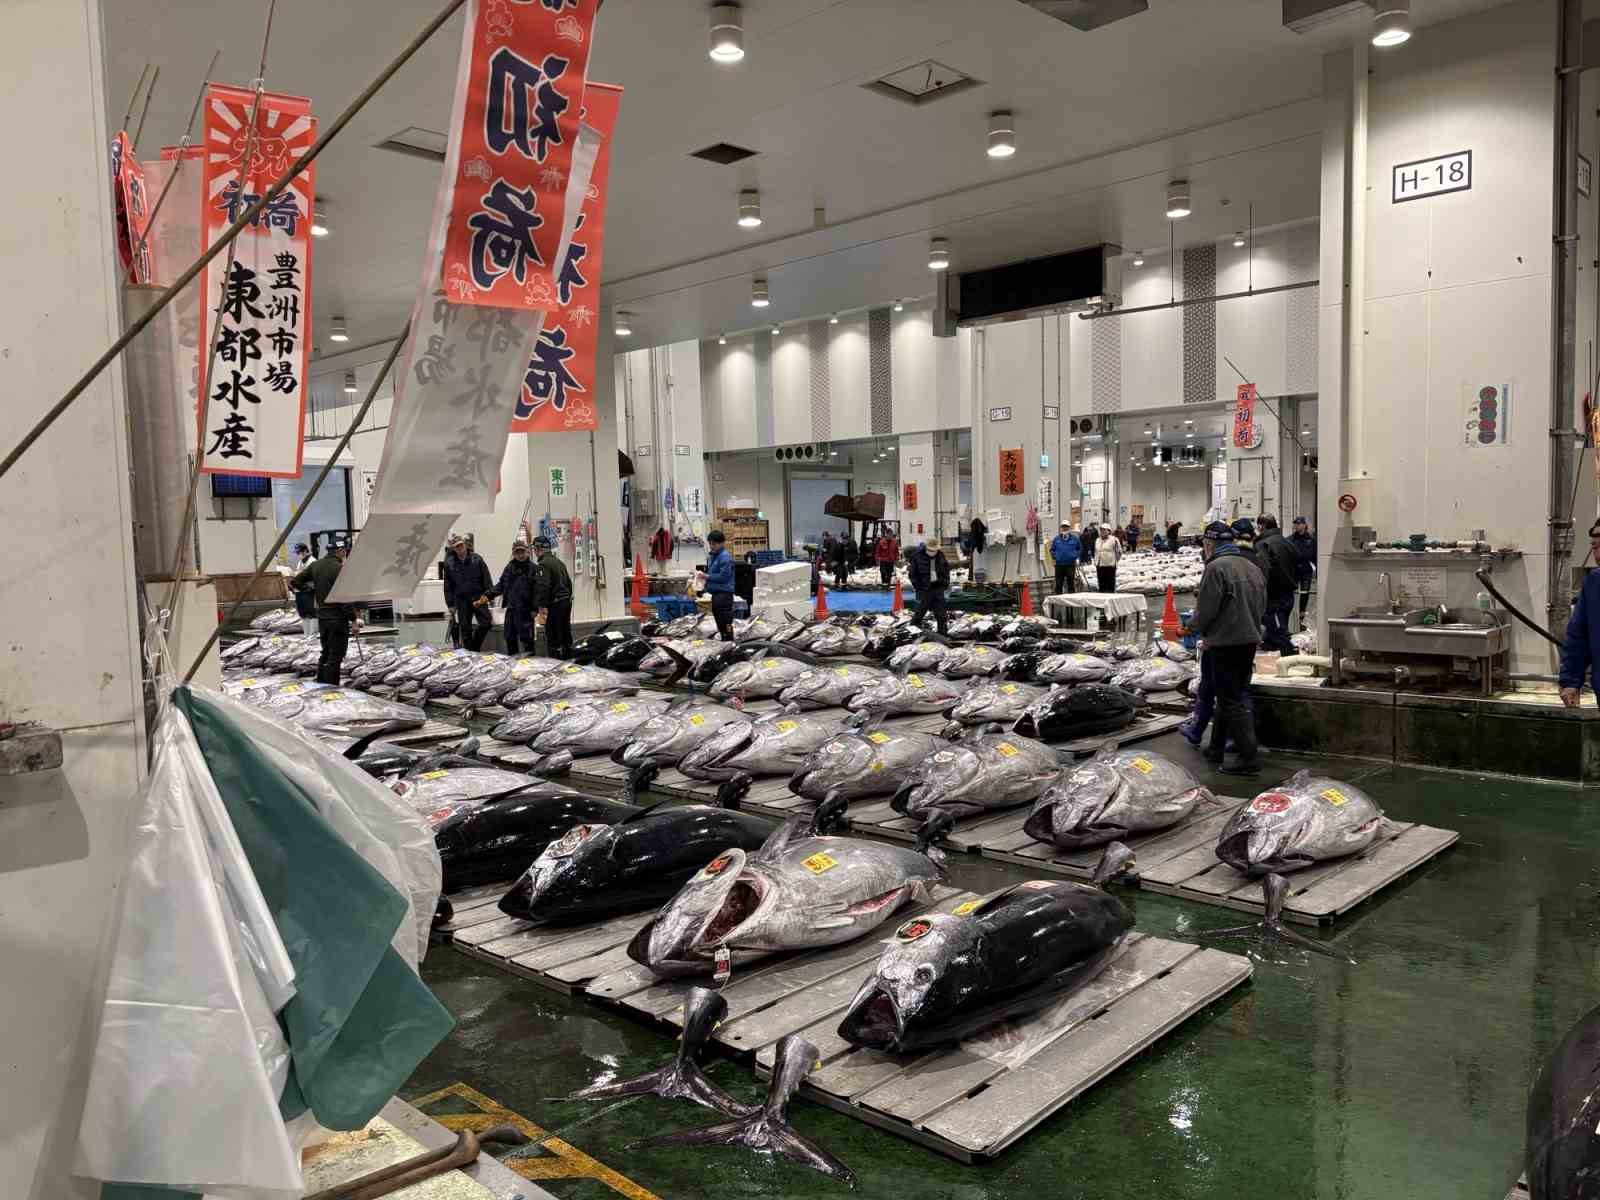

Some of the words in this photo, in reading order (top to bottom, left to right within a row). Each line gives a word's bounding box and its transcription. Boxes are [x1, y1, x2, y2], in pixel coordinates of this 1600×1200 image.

[1401, 161, 1464, 192] H-18
[217, 180, 301, 237] 初荷
[262, 251, 301, 395] 豊洲市場
[206, 260, 266, 459] 東都水産
[550, 468, 565, 496] 東市
